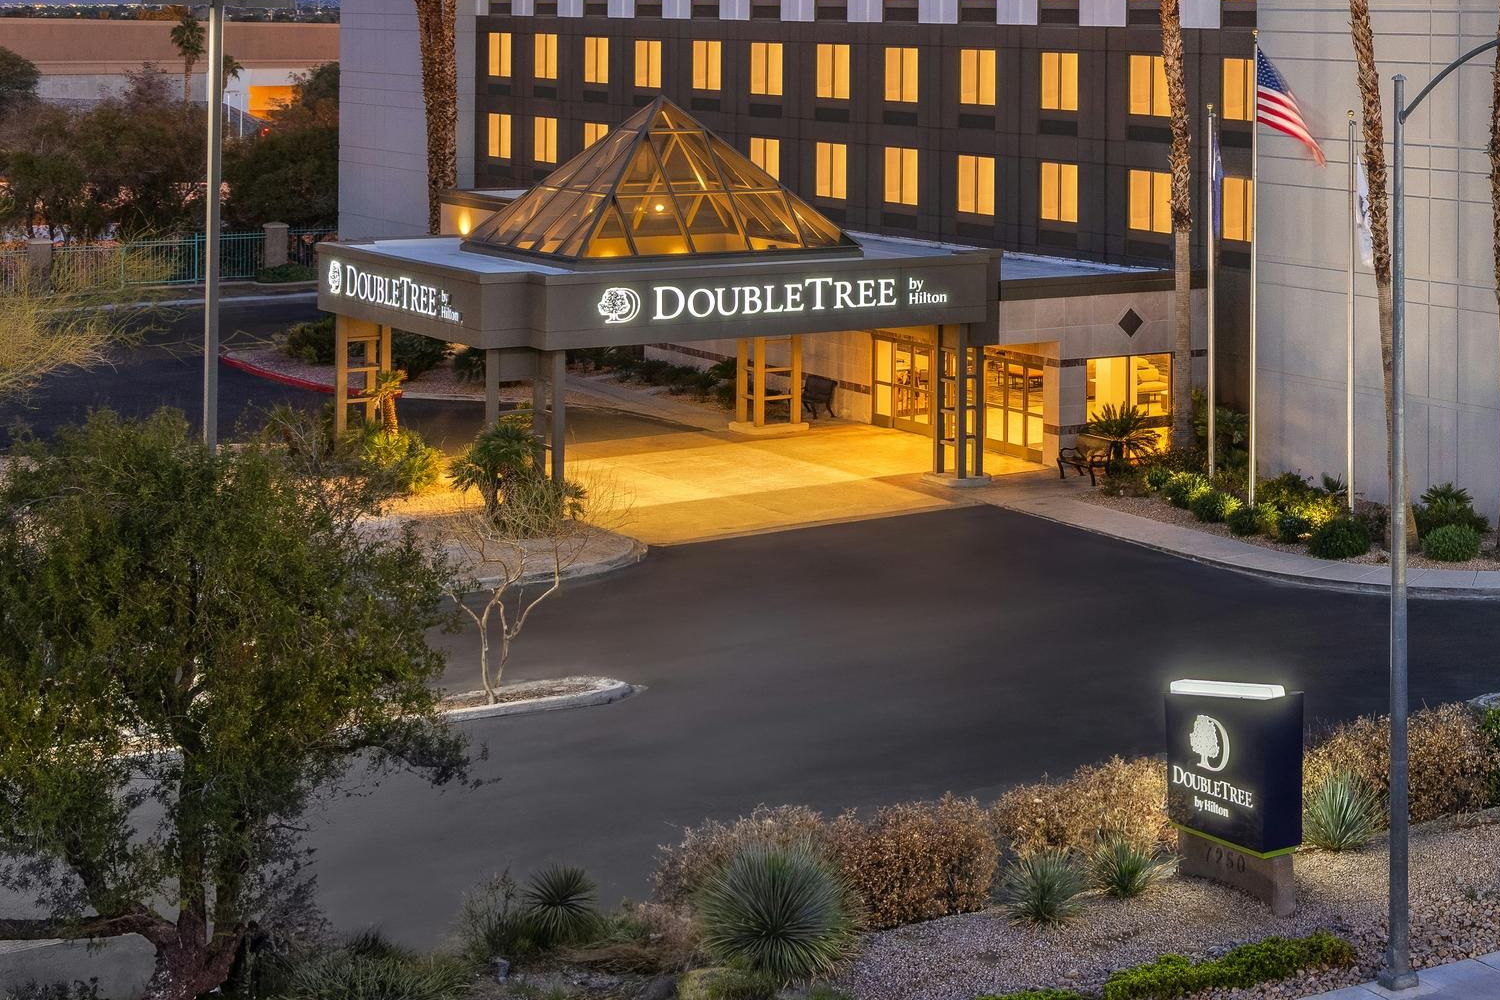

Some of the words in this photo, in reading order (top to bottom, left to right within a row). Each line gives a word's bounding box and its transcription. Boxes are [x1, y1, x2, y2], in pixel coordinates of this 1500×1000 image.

[345, 264, 437, 316] DOUBLETREE
[653, 277, 898, 321] DOUBLETREE
[908, 276, 924, 291] by
[908, 291, 948, 305] Hilton
[1172, 765, 1254, 809] DOUBLETREE
[1194, 795, 1204, 812] by
[1204, 799, 1230, 818] Hilton
